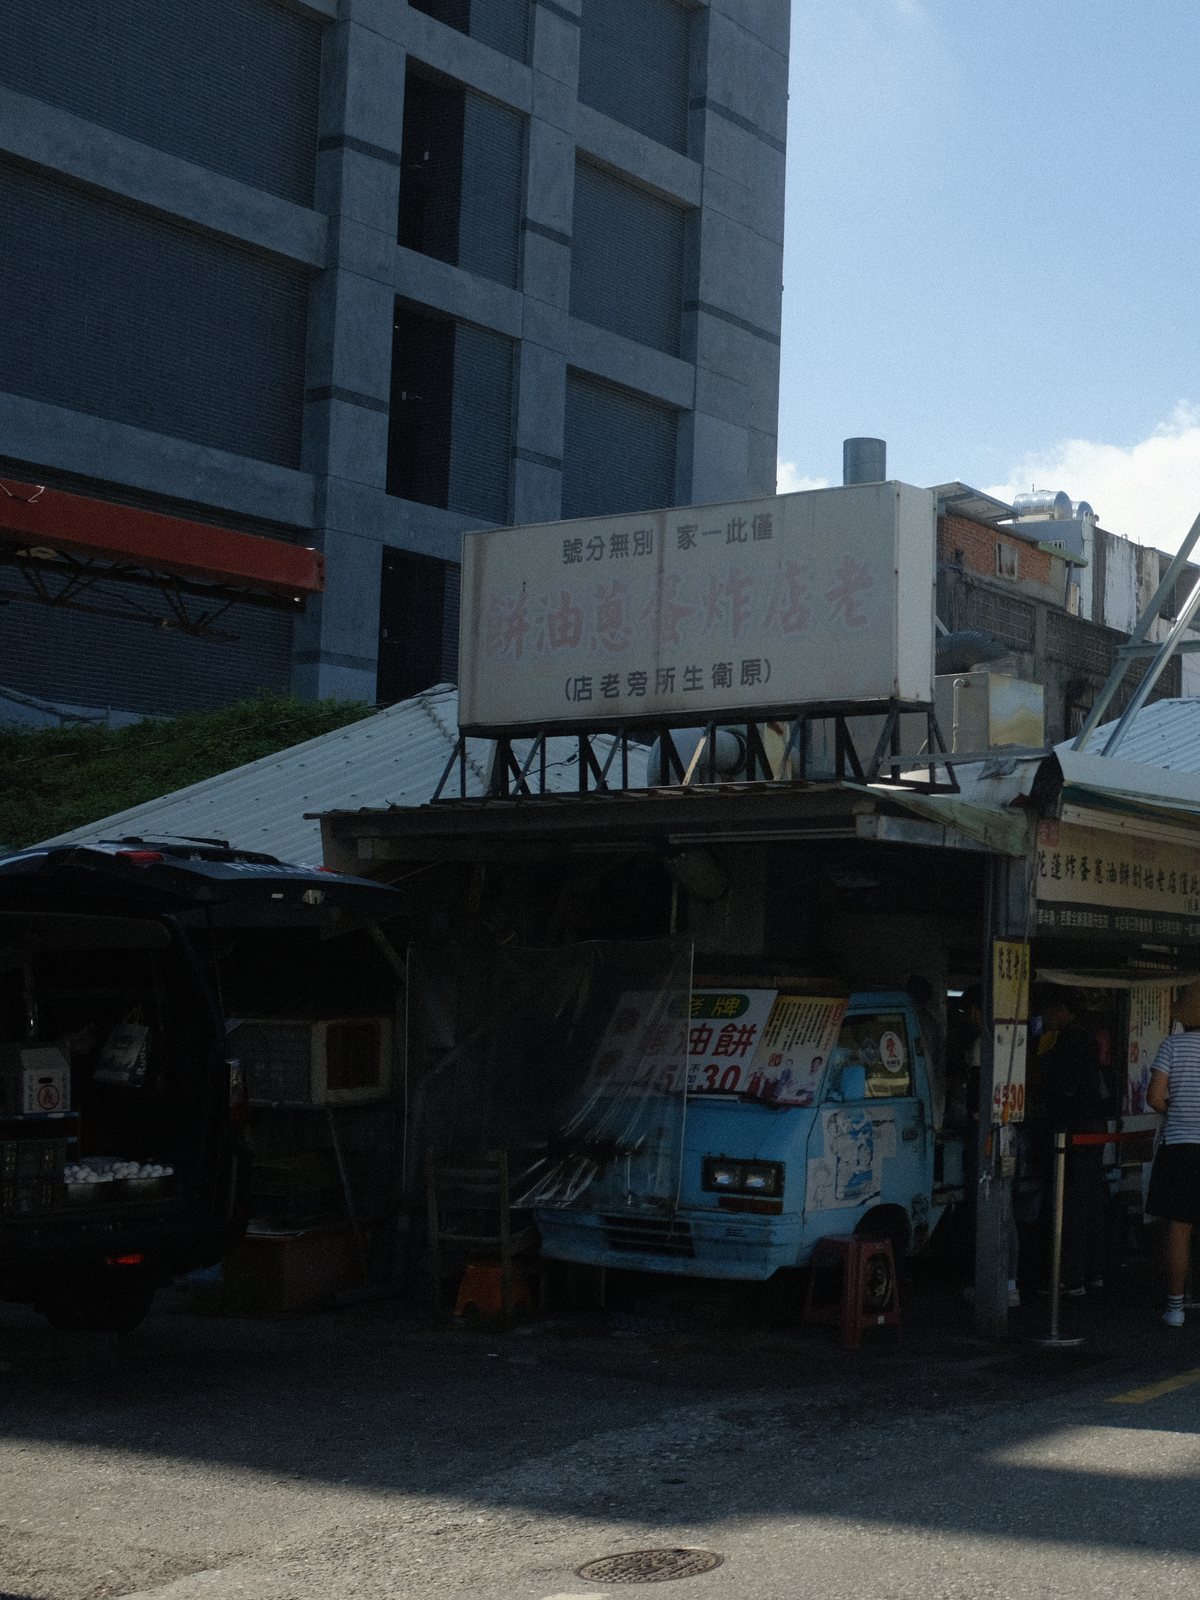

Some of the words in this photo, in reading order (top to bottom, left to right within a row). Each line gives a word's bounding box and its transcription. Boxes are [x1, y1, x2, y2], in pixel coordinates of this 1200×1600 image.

[562, 529, 655, 566] 別無分號
[676, 513, 775, 552] 僅此一家
[702, 1063, 742, 1092] 30
